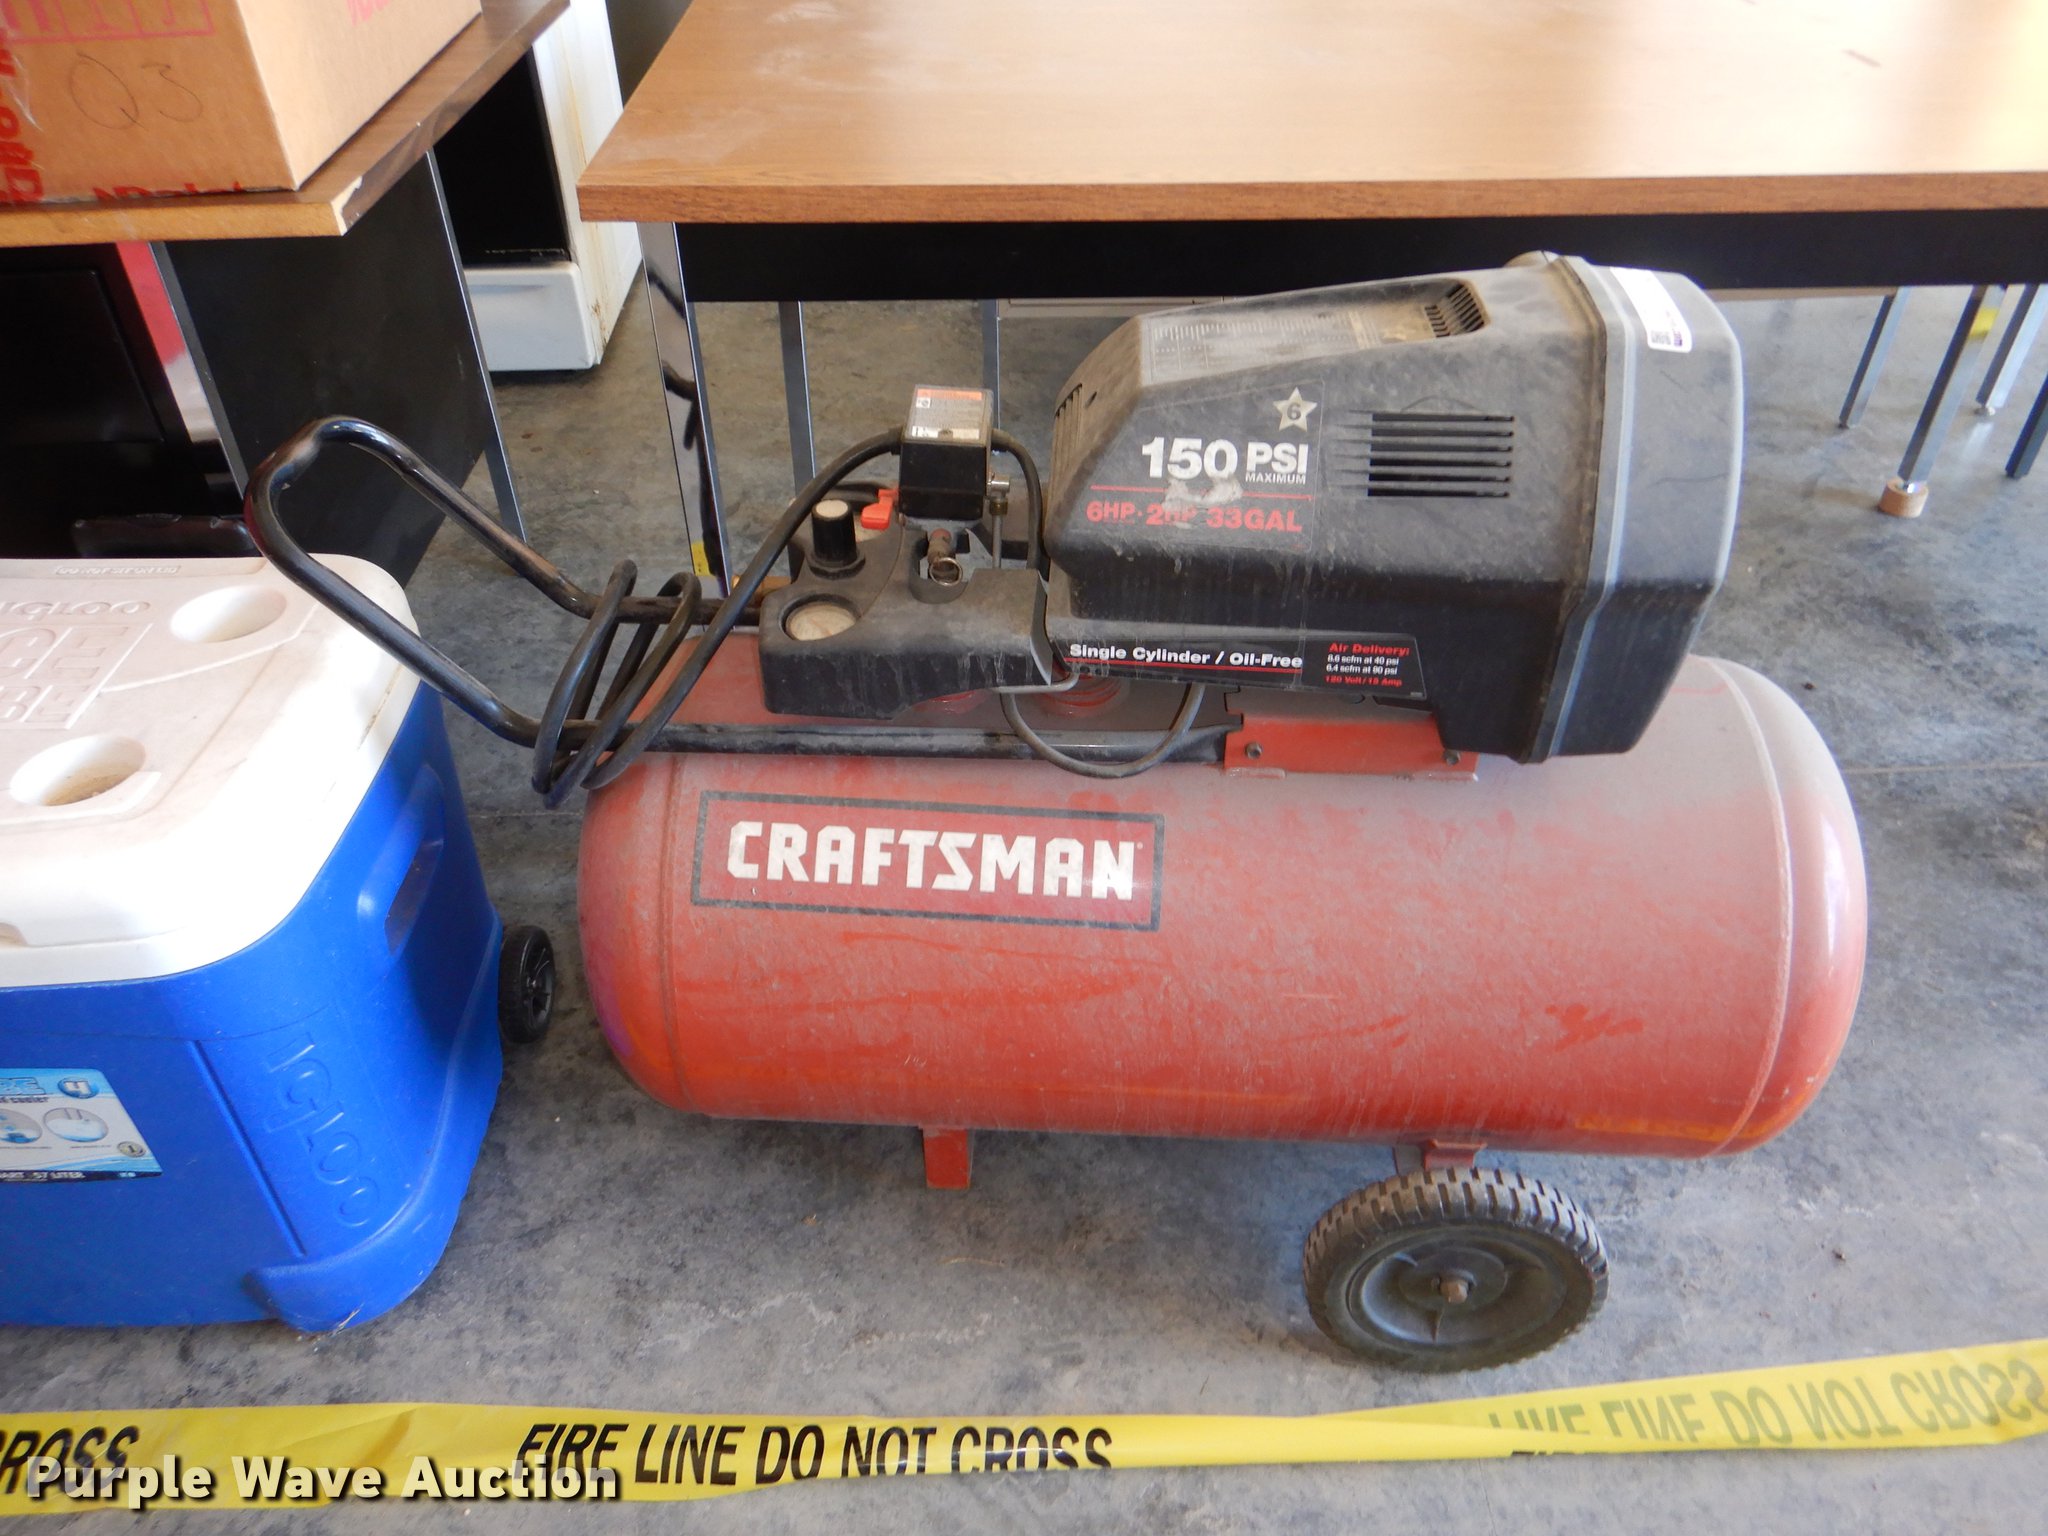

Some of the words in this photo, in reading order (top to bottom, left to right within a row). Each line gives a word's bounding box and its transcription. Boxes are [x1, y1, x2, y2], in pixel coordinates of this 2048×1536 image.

[1287, 403, 1301, 420] 6
[1142, 437, 1238, 479] 150
[1247, 442, 1309, 475] PSI
[1245, 473, 1306, 484] MAXIMUM
[1206, 506, 1303, 532] 33GAL
[1070, 643, 1127, 660] Single
[1132, 646, 1210, 663] Cylinder
[1229, 652, 1303, 668] Oil-Free
[1328, 642, 1349, 653] Air
[1341, 655, 1362, 664] scfm
[1363, 656, 1372, 665] at
[1374, 656, 1385, 665] 40
[1385, 657, 1399, 667] psi
[1340, 664, 1361, 674] scfm
[1362, 665, 1371, 674] at
[1384, 666, 1398, 676] psi
[1344, 675, 1362, 685] Volt
[1381, 677, 1403, 688] Amp
[727, 820, 1135, 901] CRAFTSMAN
[514, 1423, 630, 1482] FIRE
[635, 1424, 746, 1486] LINE
[755, 1425, 825, 1485] DO
[841, 1426, 937, 1478] NOT
[950, 1426, 1113, 1474] CROSS
